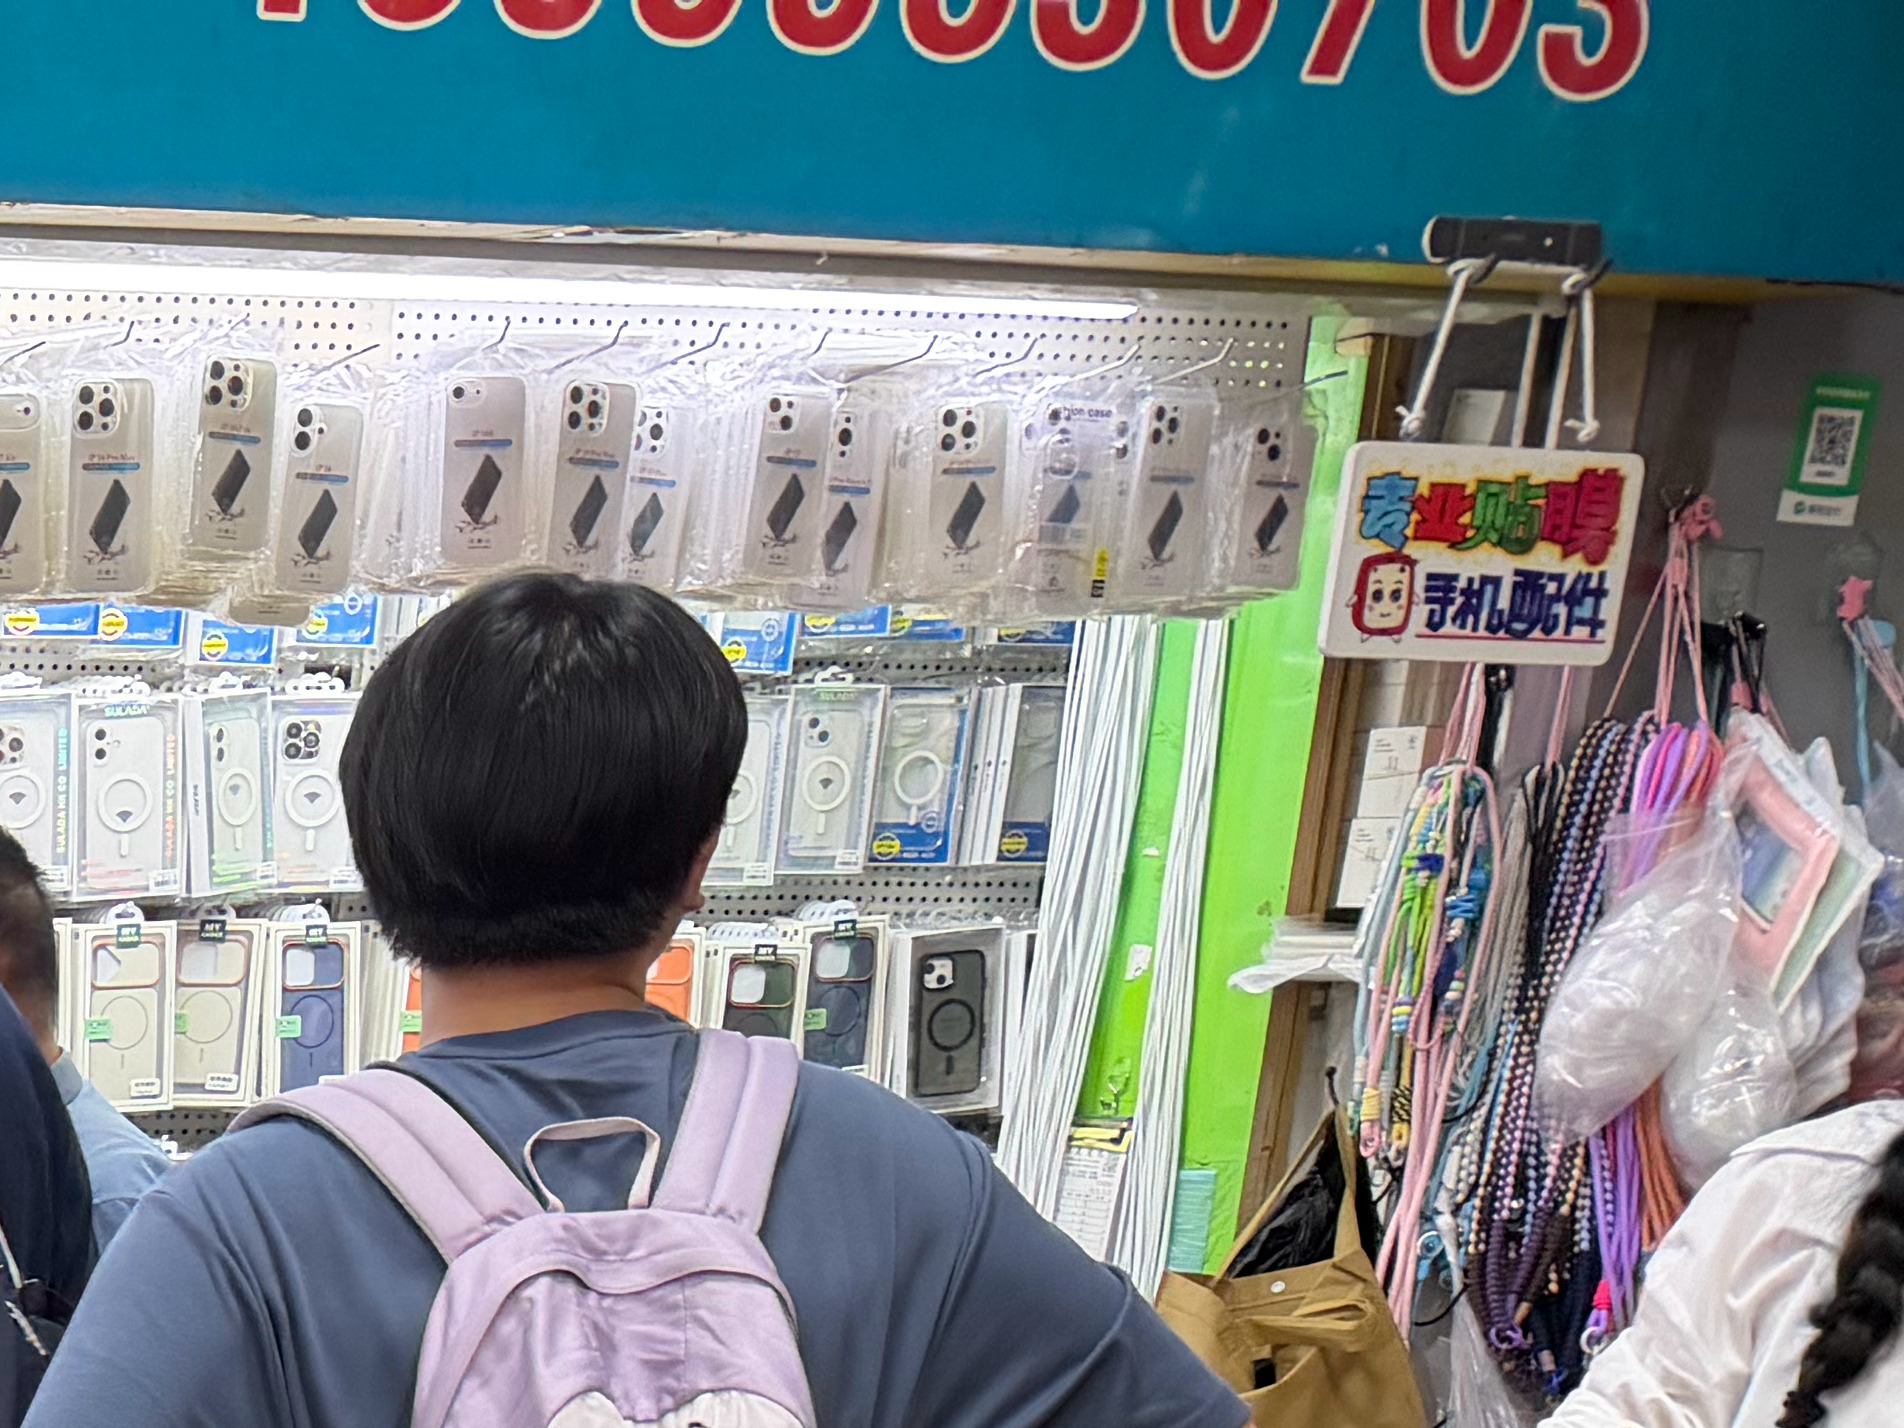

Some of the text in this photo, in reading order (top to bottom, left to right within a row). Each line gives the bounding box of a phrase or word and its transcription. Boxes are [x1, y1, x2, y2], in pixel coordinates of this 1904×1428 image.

[1359, 468, 1624, 566] 专业贴膜
[1423, 567, 1609, 640] 手机配件
